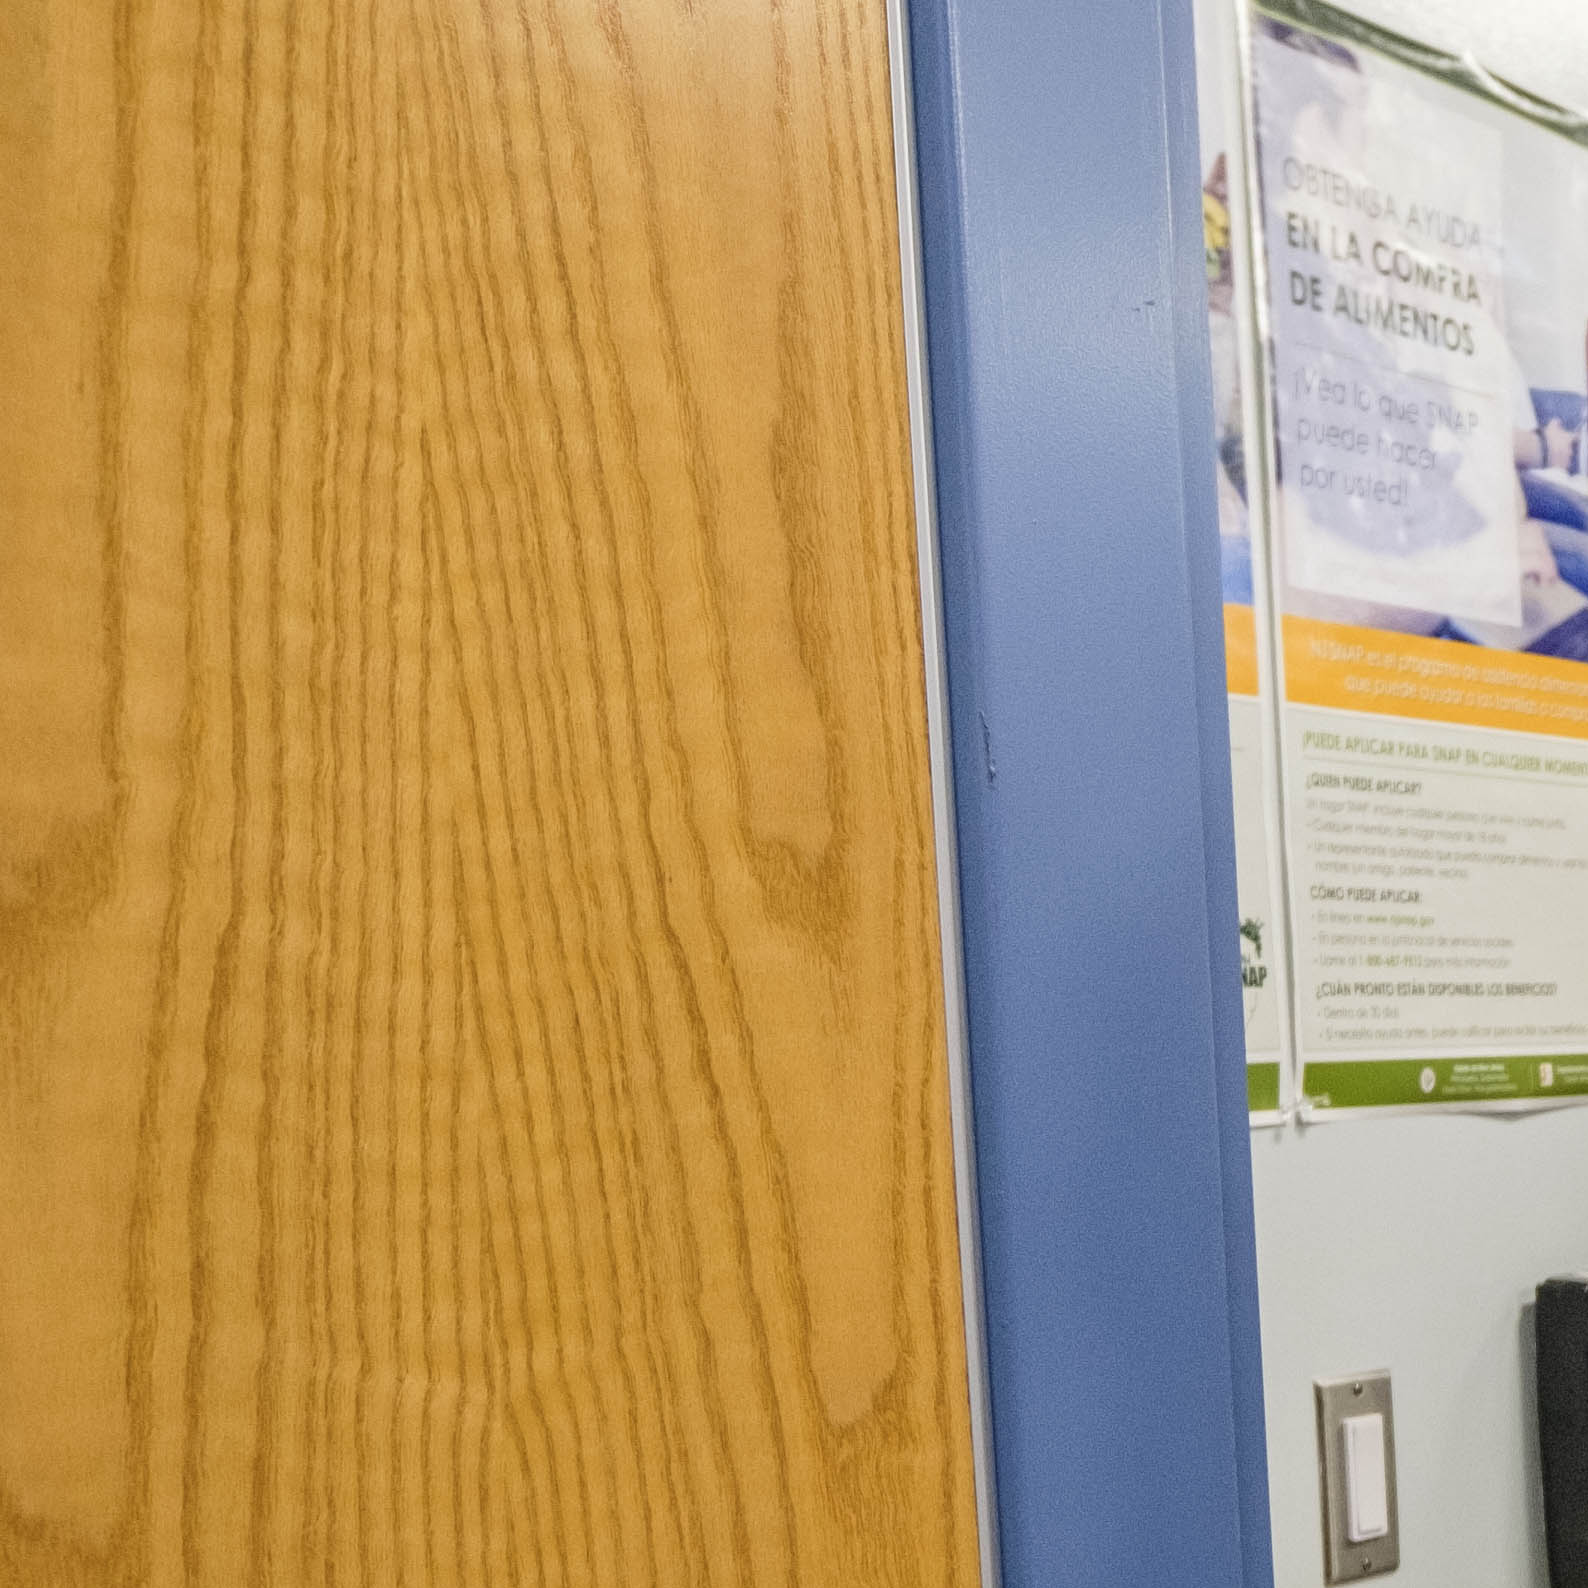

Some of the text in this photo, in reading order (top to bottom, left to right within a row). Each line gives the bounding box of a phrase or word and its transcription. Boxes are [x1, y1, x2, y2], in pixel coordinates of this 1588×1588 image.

[1283, 156, 1480, 248] OBTENGA AYUDA
[1286, 211, 1320, 254] EN
[1331, 225, 1362, 265] LA
[1290, 270, 1474, 356] DE ALIMENTOS
[1379, 395, 1419, 424] que
